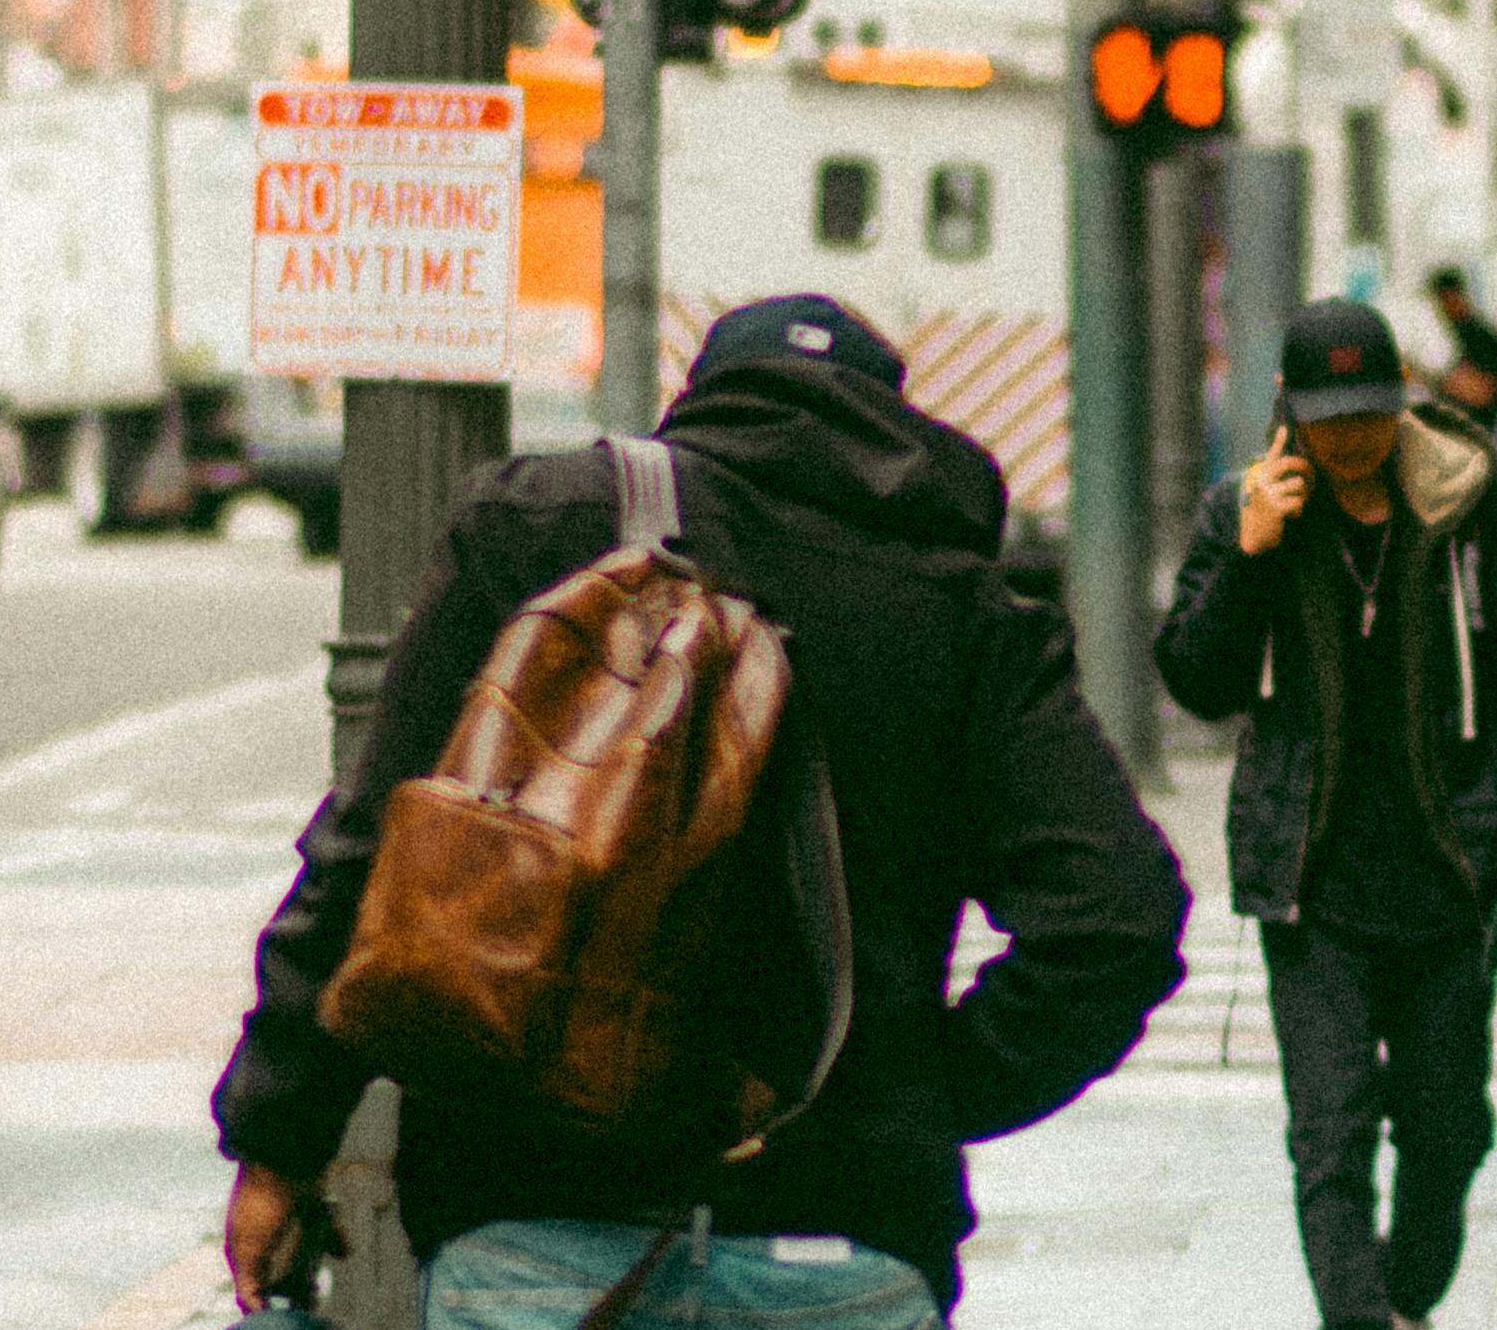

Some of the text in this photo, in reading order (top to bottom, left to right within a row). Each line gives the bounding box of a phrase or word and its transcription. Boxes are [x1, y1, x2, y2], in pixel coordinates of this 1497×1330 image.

[294, 134, 476, 156] TEMPORARY
[267, 167, 501, 233] NO PARKING
[276, 245, 486, 299] ANYTIME
